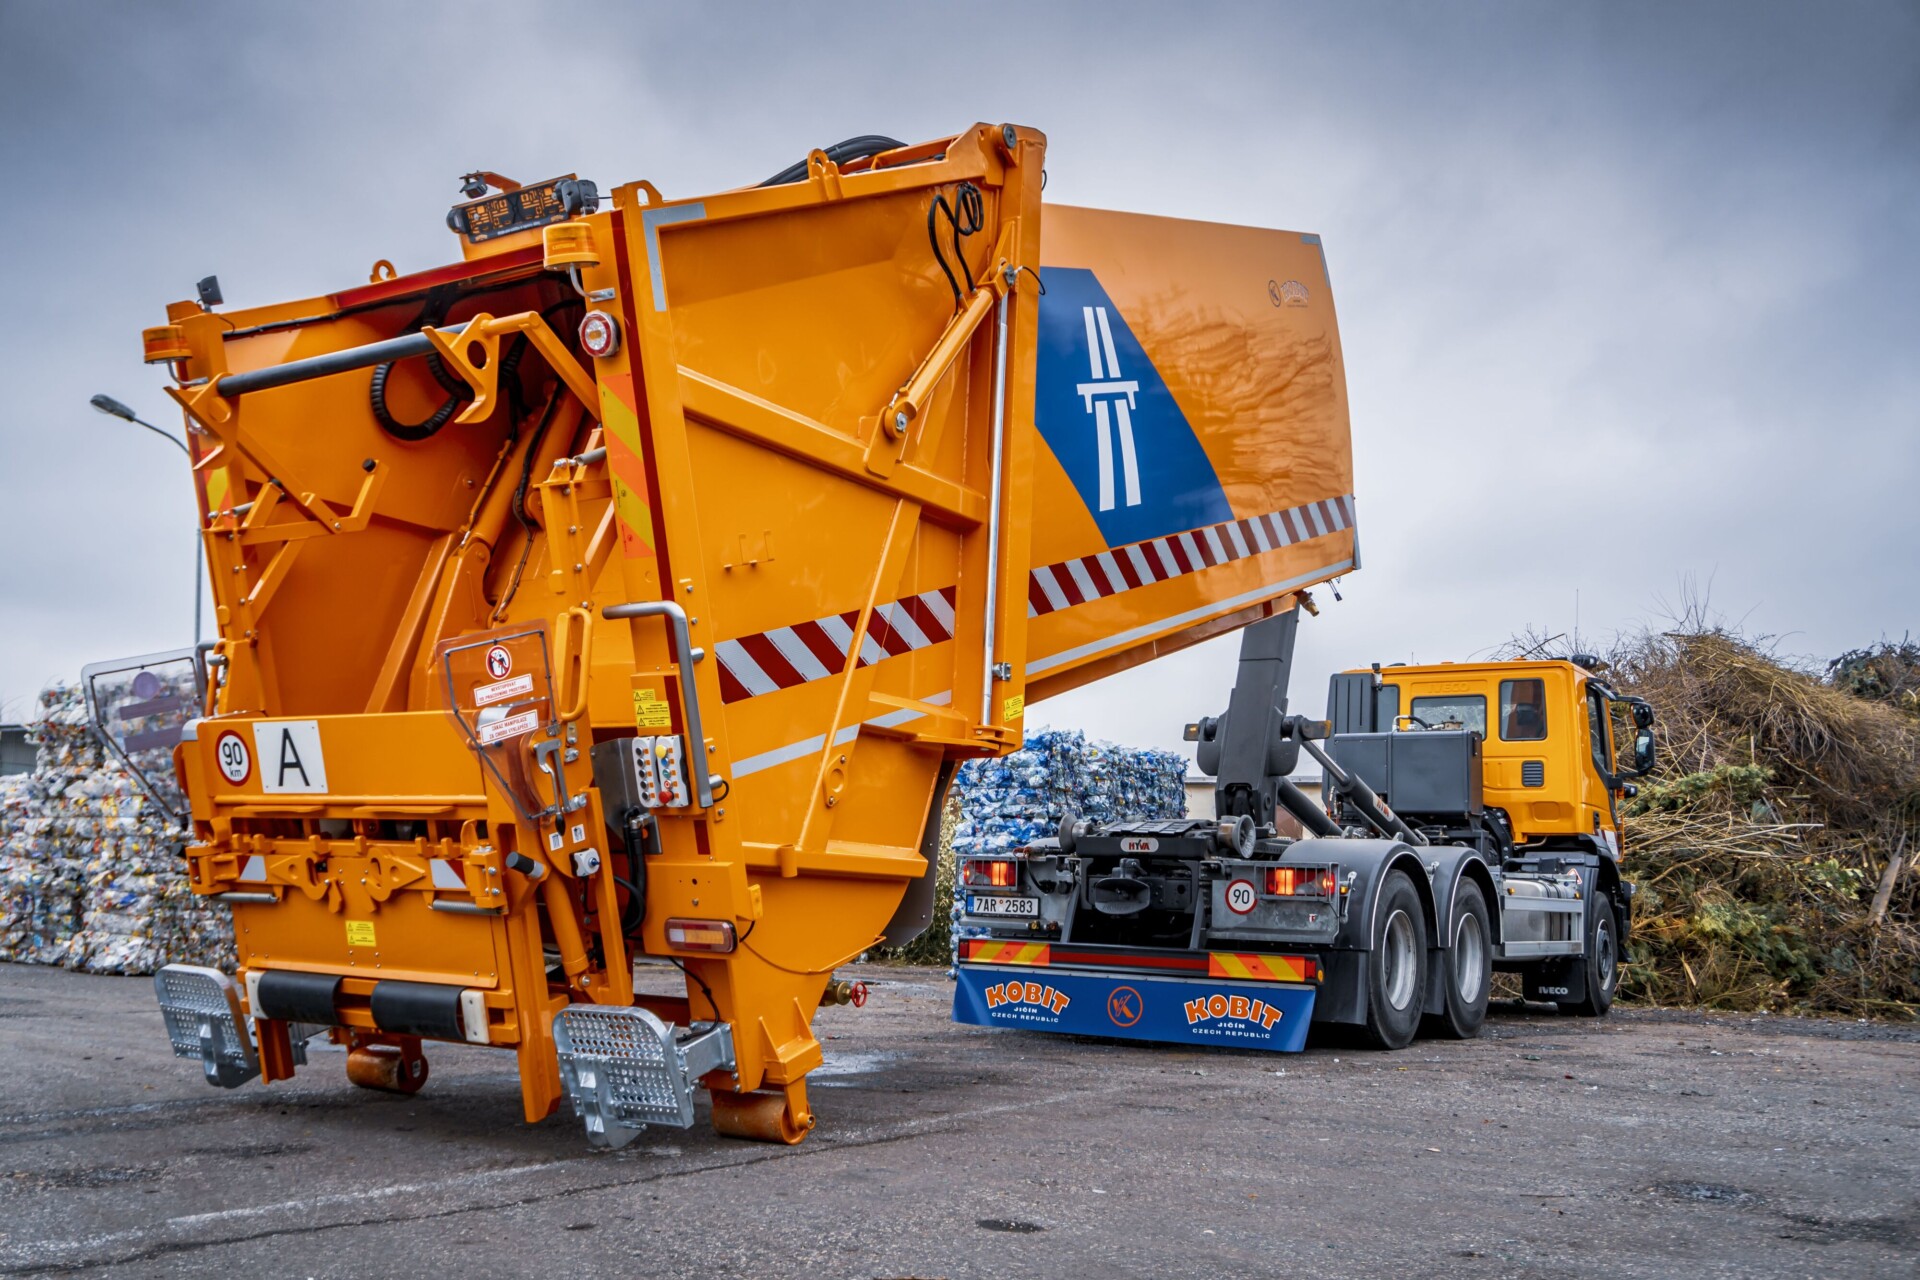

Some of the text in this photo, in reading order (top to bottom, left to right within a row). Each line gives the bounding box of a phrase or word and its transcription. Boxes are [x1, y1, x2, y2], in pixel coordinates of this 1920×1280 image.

[222, 741, 243, 766] 90
[278, 728, 310, 787] A
[229, 767, 242, 777] km
[1129, 839, 1150, 850] HYVA
[1233, 889, 1250, 904] 90
[976, 898, 1033, 913] 7AR 2583
[985, 980, 1071, 1016] KOBIT
[1538, 986, 1568, 995] IVECO
[1020, 1014, 1059, 1023] REPUBLIC
[1183, 994, 1283, 1031] KOBIT
[1225, 1030, 1271, 1039] REPUBLIC
